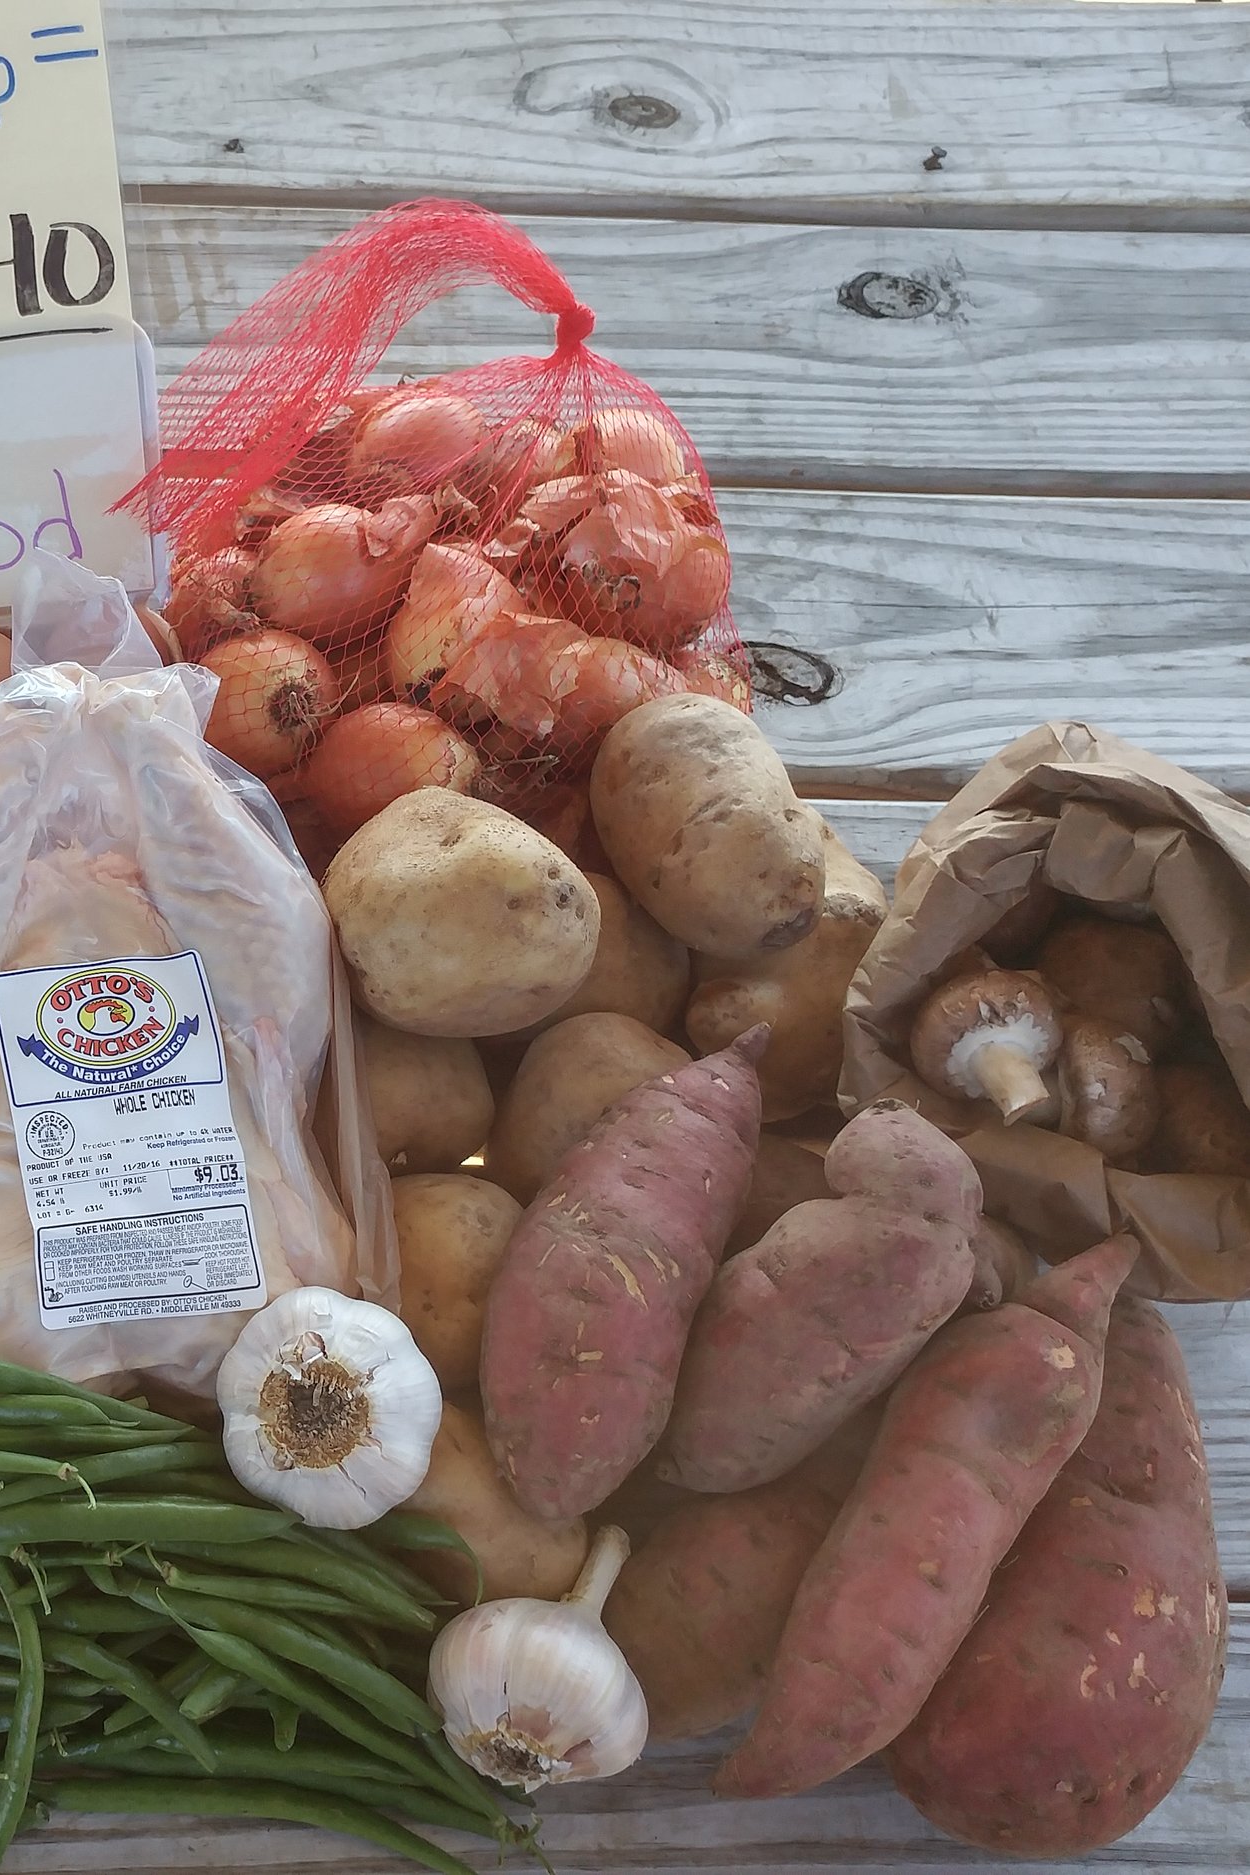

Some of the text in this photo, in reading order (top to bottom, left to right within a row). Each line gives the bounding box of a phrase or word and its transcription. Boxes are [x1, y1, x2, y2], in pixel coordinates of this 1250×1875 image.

[31, 24, 100, 64] =
[50, 975, 155, 1012] OTTO'S
[56, 1016, 166, 1058] CHICKEN
[41, 1048, 68, 1073] The
[141, 1033, 186, 1072] Choice
[54, 1075, 186, 1099] ALL NATURAL FARM CHICKEN
[113, 1088, 195, 1114] WHOLE CHICKEN
[30, 1114, 69, 1136] INSPECTED
[82, 1139, 116, 1149] Product
[139, 1132, 172, 1141] contain
[211, 1126, 233, 1134] WATER
[147, 1141, 164, 1149] Keep
[166, 1138, 205, 1147] Refrigerated
[26, 1152, 112, 1171] PRODUCT OF THE USA
[123, 1160, 160, 1171] 11/20/16
[29, 1176, 43, 1185] USE
[47, 1174, 57, 1182] OR
[61, 1169, 90, 1179] FREEZE
[99, 1175, 147, 1188] UNIT PRICE
[194, 1163, 237, 1183] $9.03
[35, 1189, 49, 1197] NET
[184, 1191, 210, 1199] Artificial
[212, 1188, 245, 1197] Ingredients
[36, 1211, 50, 1219] LOT
[75, 1213, 204, 1235] SAFE HANDLING INSTRUCTIONS
[144, 1255, 172, 1263] SEPARATE
[81, 1284, 106, 1292] TOUCHING
[79, 1305, 102, 1313] RAISED
[118, 1299, 159, 1309] PROCESSED
[173, 1296, 197, 1305] OTTO'S
[198, 1294, 227, 1303] CHICKEN
[85, 1308, 138, 1320] WHITNEYVILLE
[160, 1303, 209, 1314] MIDDLEVILLE
[220, 1299, 240, 1308] 49333
